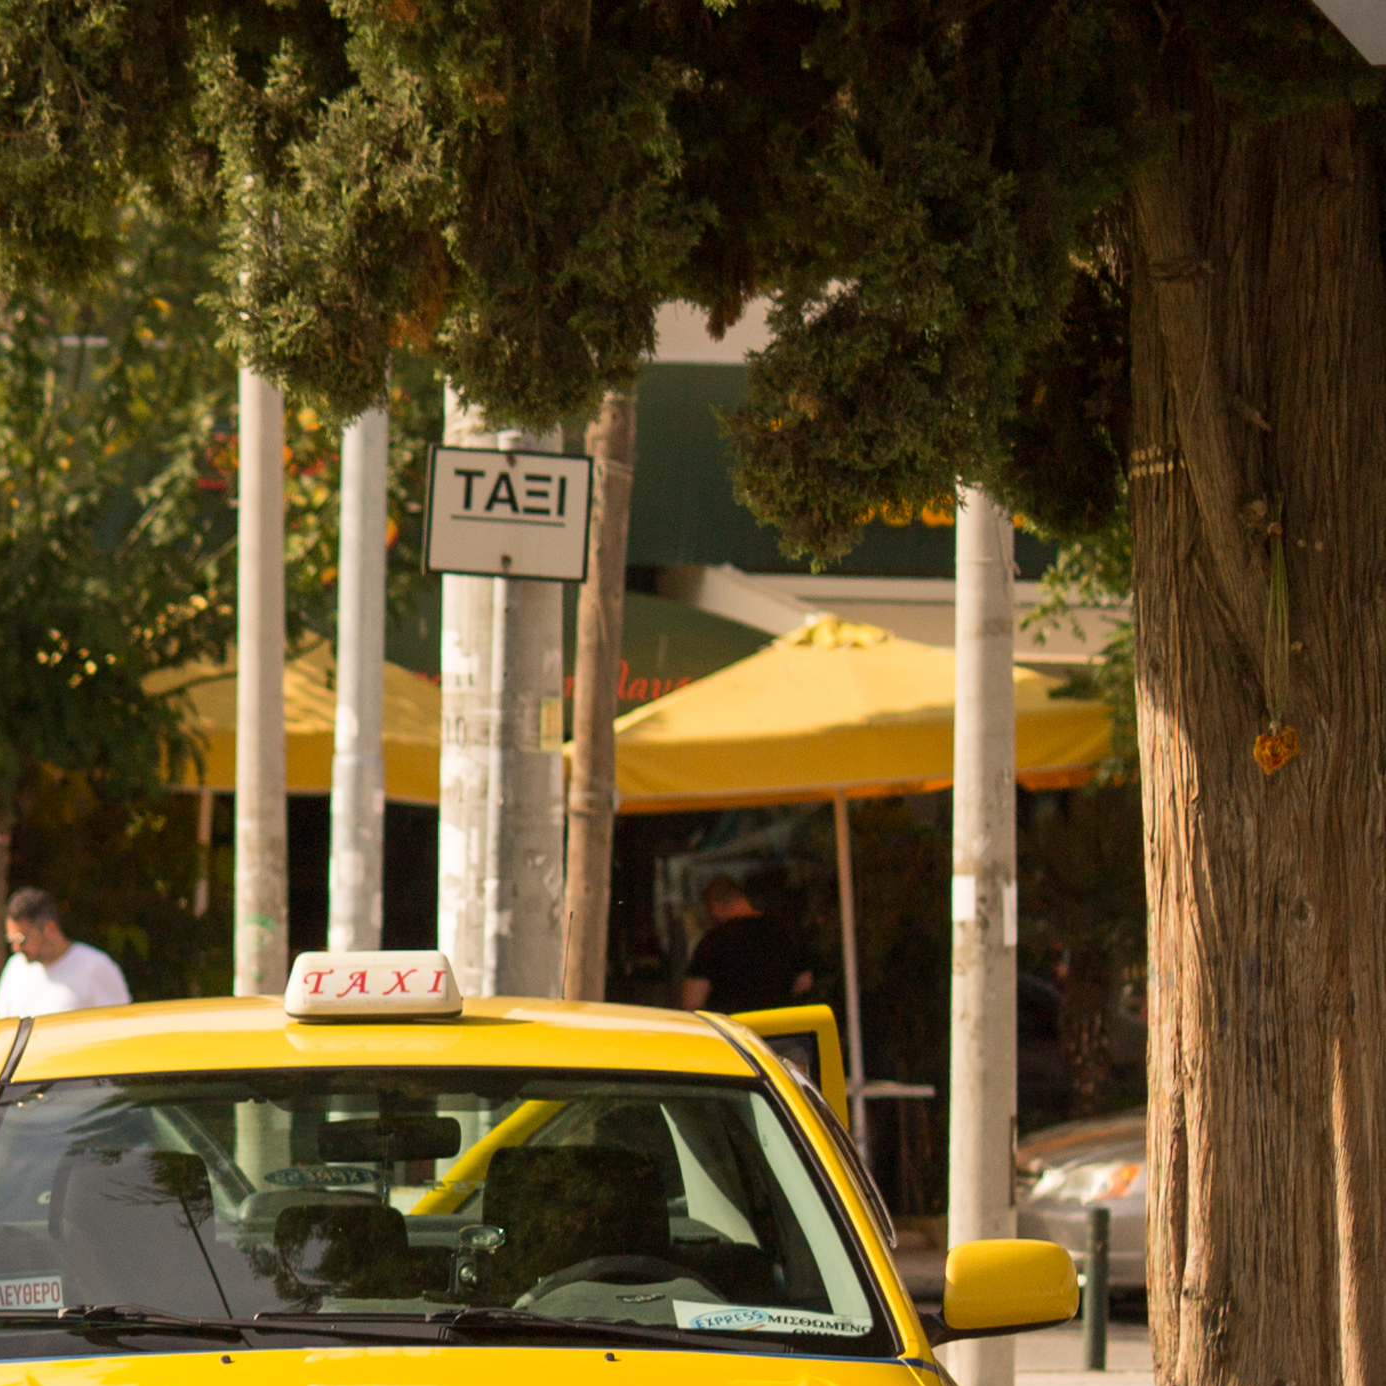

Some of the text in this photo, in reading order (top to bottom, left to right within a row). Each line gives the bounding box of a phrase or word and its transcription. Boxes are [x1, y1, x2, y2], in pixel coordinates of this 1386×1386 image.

[454, 468, 567, 516] ΤΑΞΙ
[303, 968, 447, 998] TAXI
[695, 1309, 764, 1329] EXPRESS
